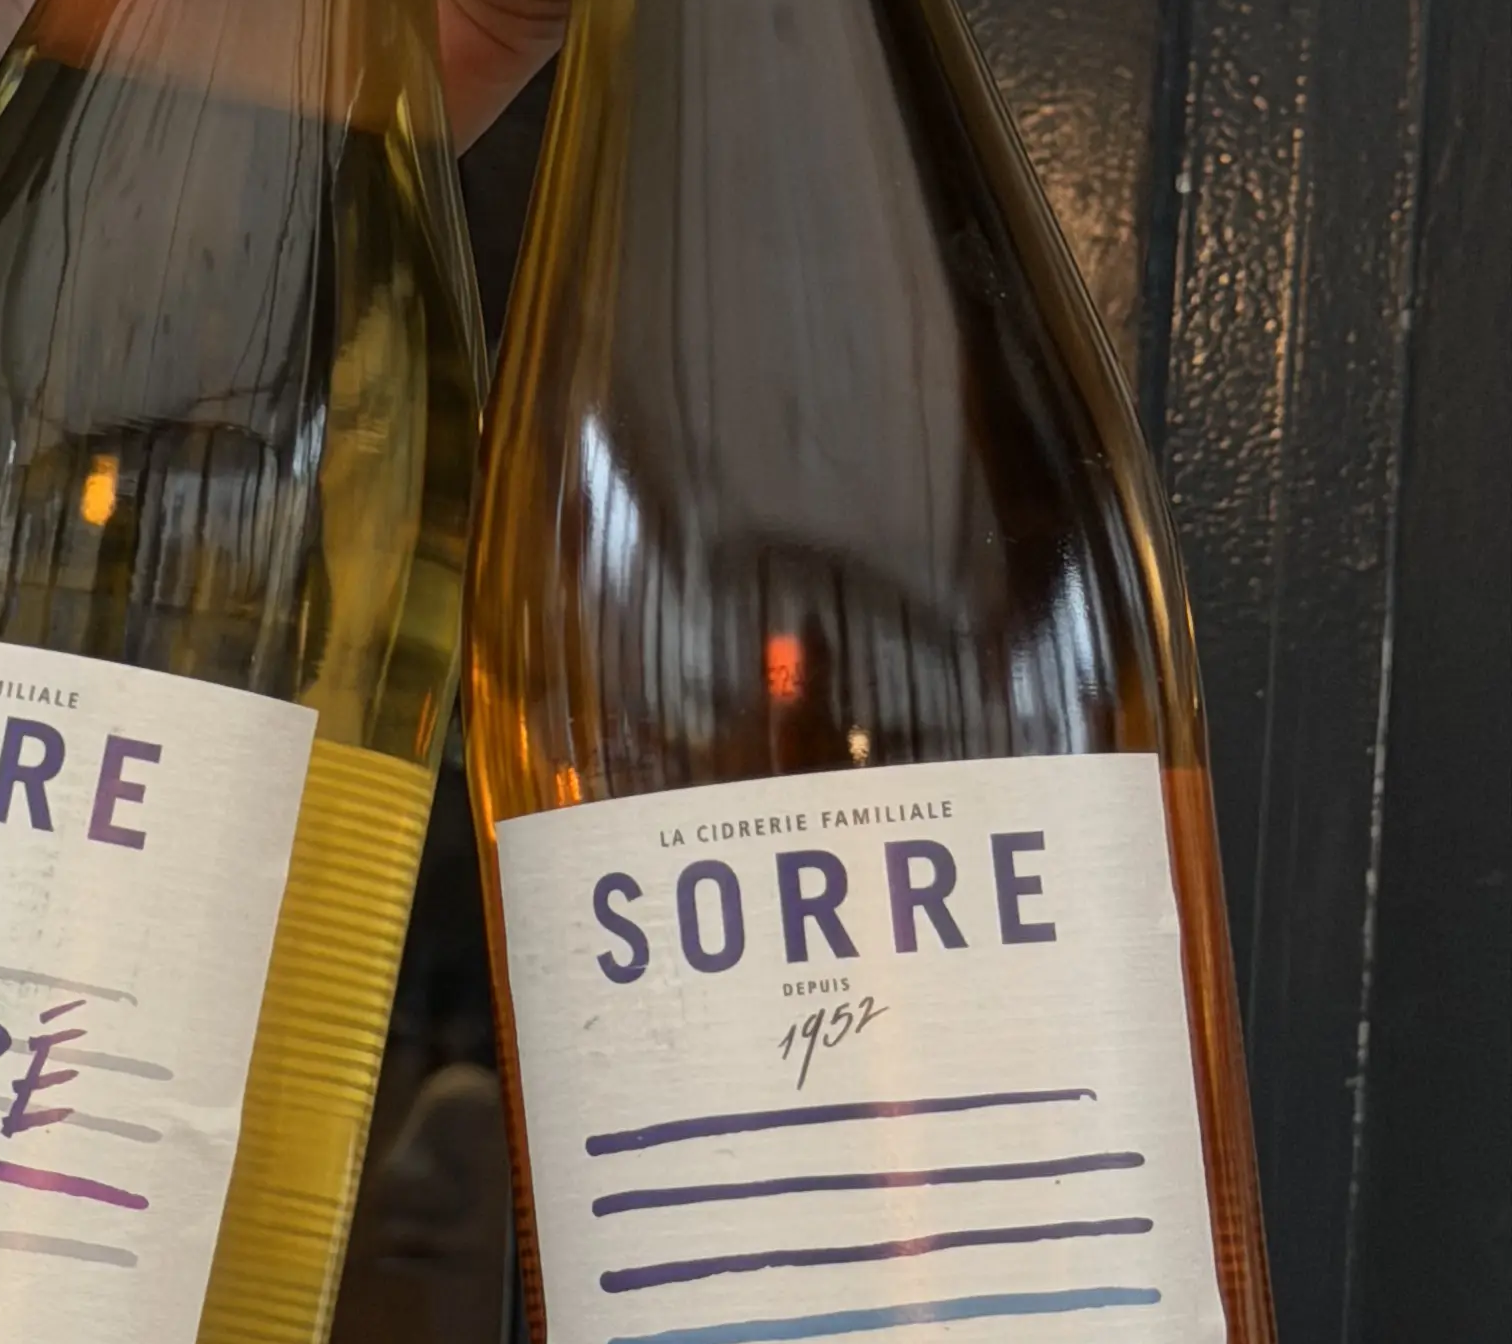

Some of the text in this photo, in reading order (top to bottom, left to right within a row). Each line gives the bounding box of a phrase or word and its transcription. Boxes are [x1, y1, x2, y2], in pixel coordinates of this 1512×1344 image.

[660, 800, 953, 848] LA CIDRERIE FAMILIALE
[592, 830, 1057, 985] SORRE
[782, 977, 851, 998] DEPUIS
[778, 996, 889, 1091] 1952
